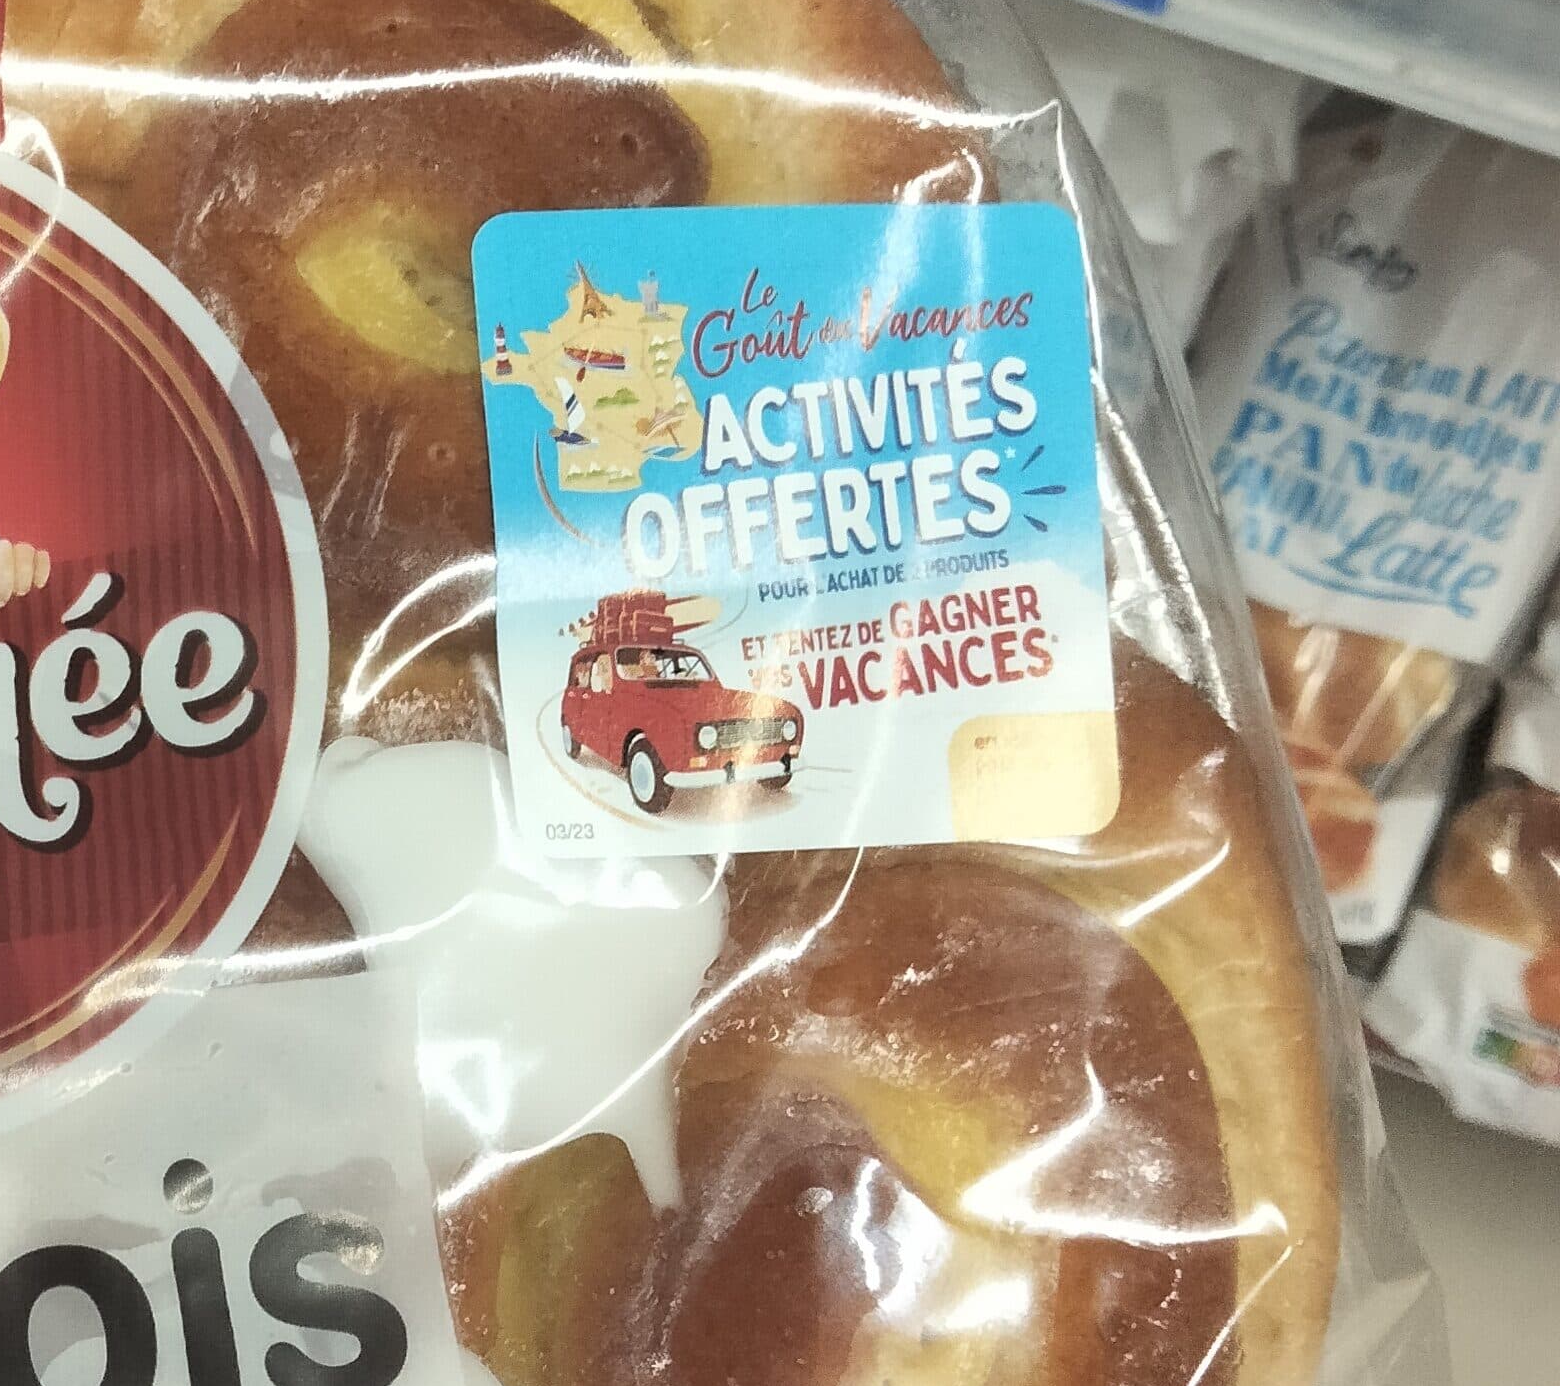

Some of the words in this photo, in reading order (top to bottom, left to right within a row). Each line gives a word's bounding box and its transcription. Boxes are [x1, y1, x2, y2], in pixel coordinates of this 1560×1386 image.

[742, 266, 778, 314] Le
[691, 300, 812, 379] Goût
[861, 286, 1033, 353] Vacances
[702, 341, 1038, 474] ACTIVITÉS
[758, 577, 809, 602] POUR
[884, 562, 905, 585] DE
[740, 635, 767, 661] ET
[857, 618, 885, 646] DE
[890, 584, 1042, 639] GAGNER
[545, 822, 595, 840] 03/23
